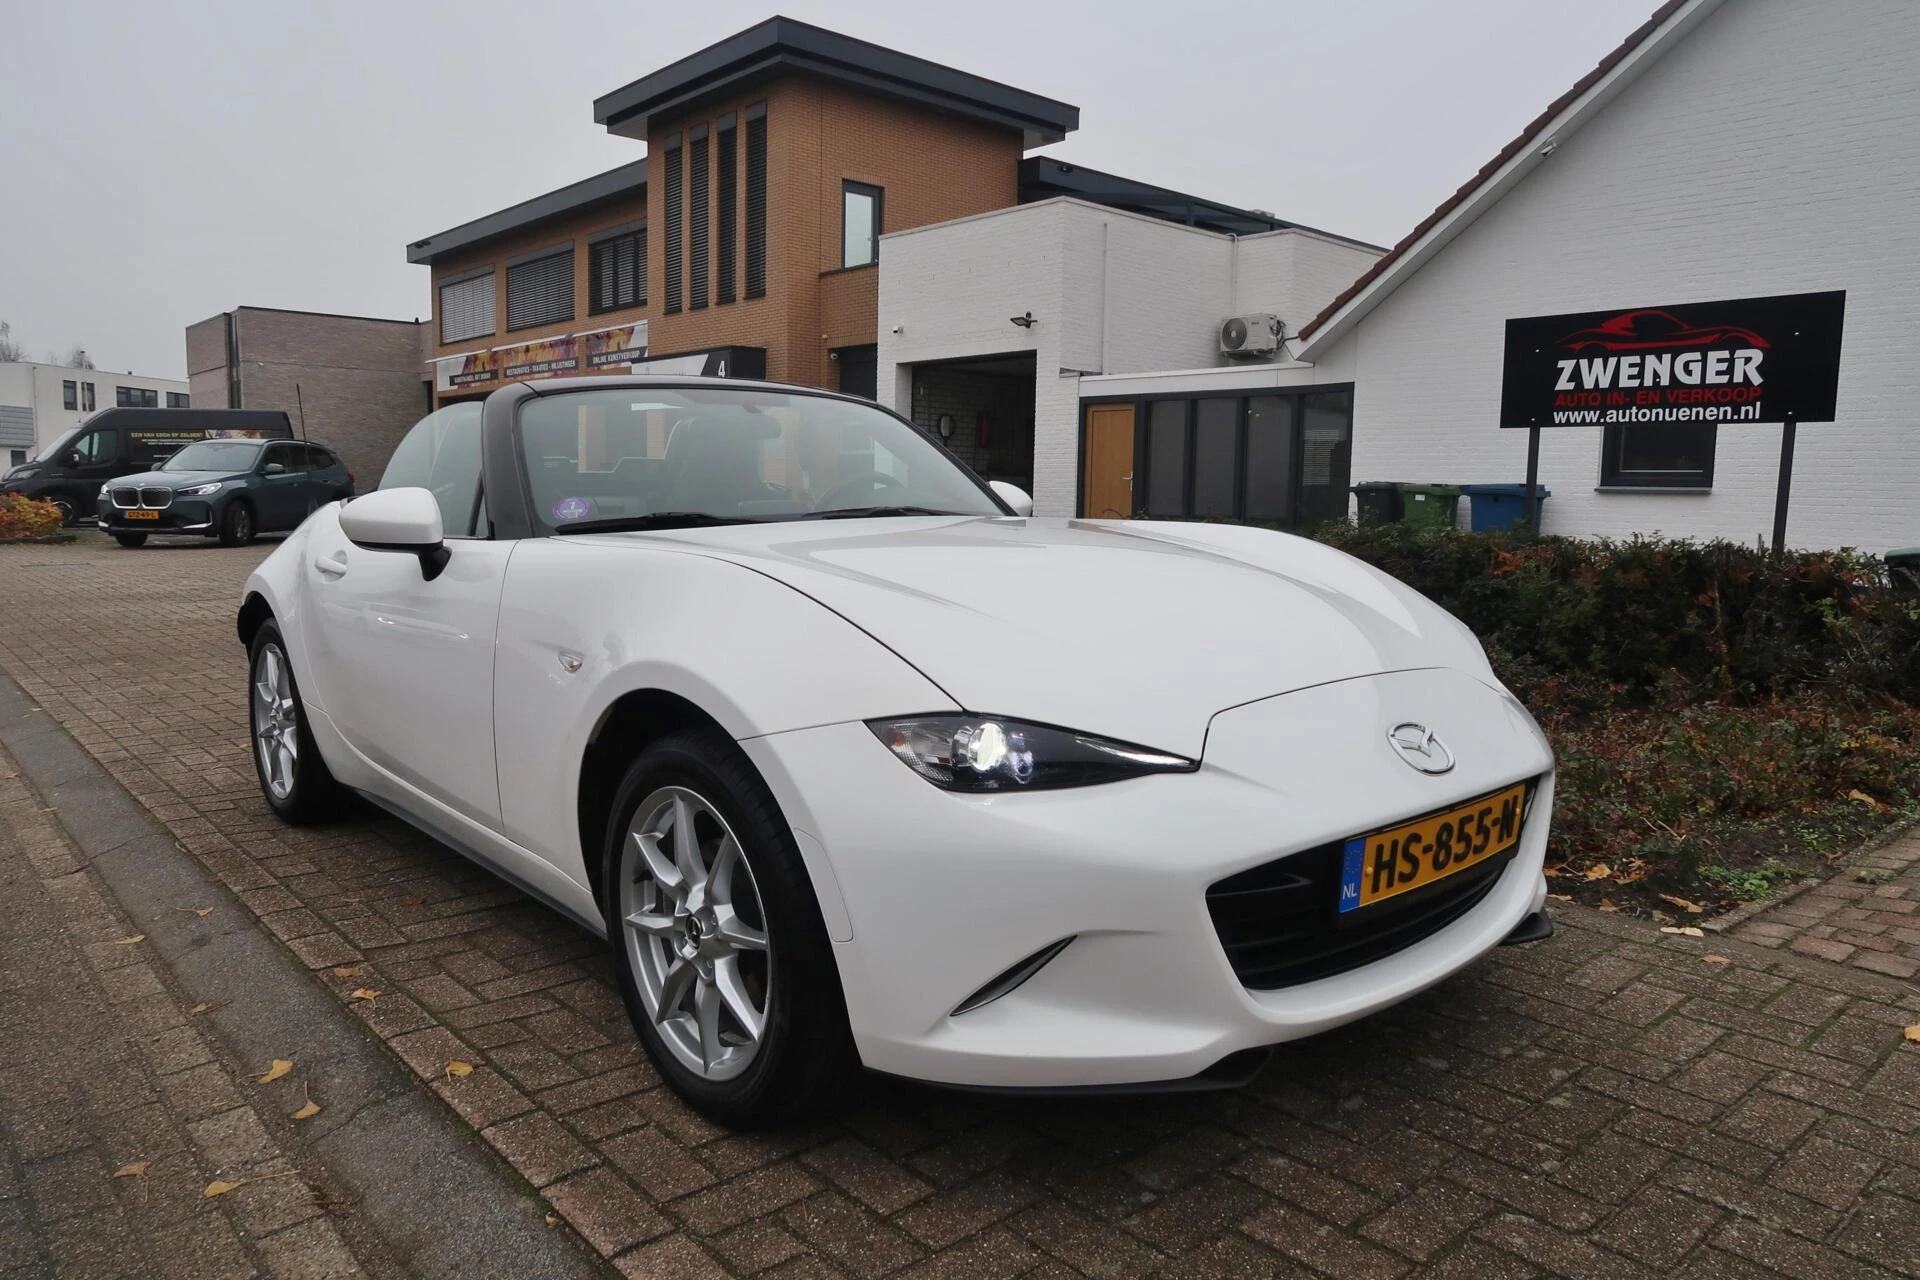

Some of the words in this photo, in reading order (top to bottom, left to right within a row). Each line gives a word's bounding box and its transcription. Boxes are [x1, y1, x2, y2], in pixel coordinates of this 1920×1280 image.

[717, 360, 726, 377] 4
[1554, 348, 1764, 391] ZWENGER
[1555, 391, 1602, 408] AUTO
[1607, 390, 1631, 405] IN-
[1638, 390, 1660, 405] EN
[1667, 387, 1763, 403] VERKOOP
[1553, 402, 1761, 424] www.autonuenen.nl
[1371, 794, 1519, 895] HS-855-N
[1342, 885, 1358, 899] NL
